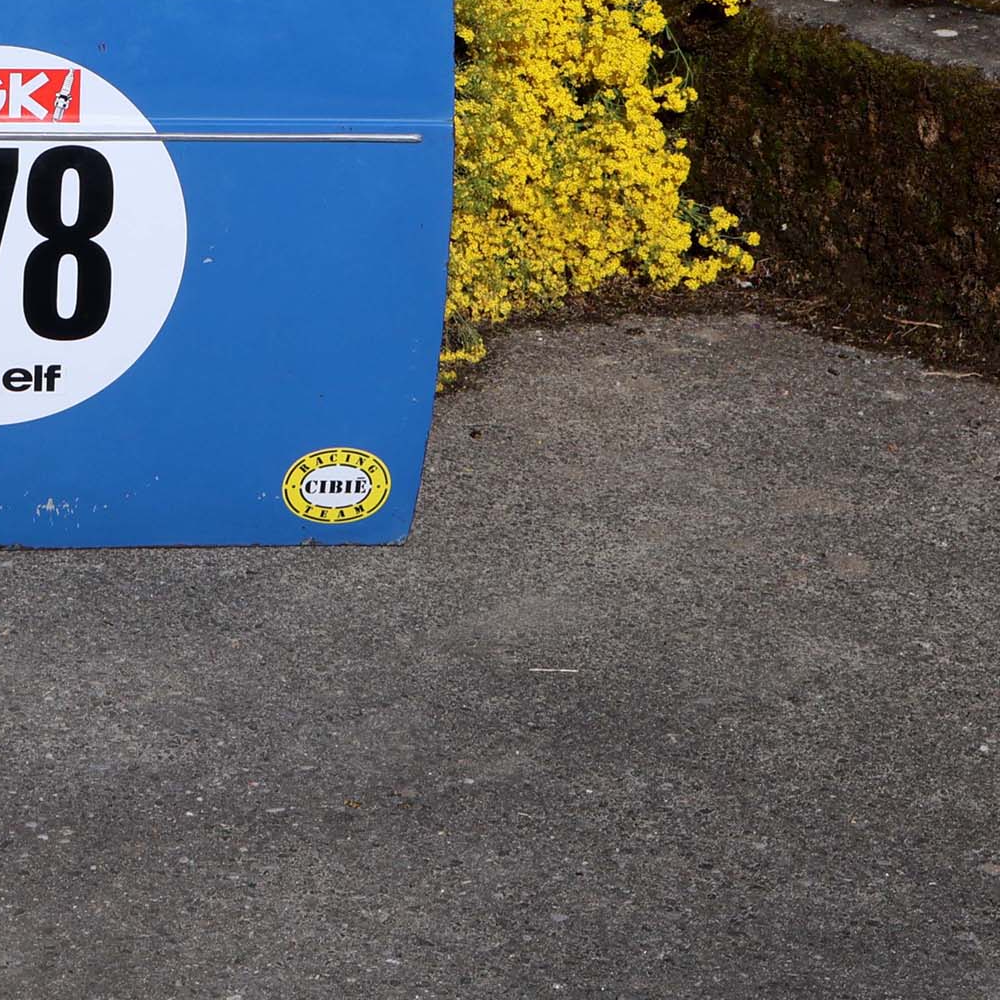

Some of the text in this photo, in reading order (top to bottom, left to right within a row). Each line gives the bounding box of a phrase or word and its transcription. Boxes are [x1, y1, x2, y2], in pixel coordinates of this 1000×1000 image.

[2, 364, 62, 393] elf
[299, 454, 377, 474] RACING
[305, 505, 365, 518] TEAM
